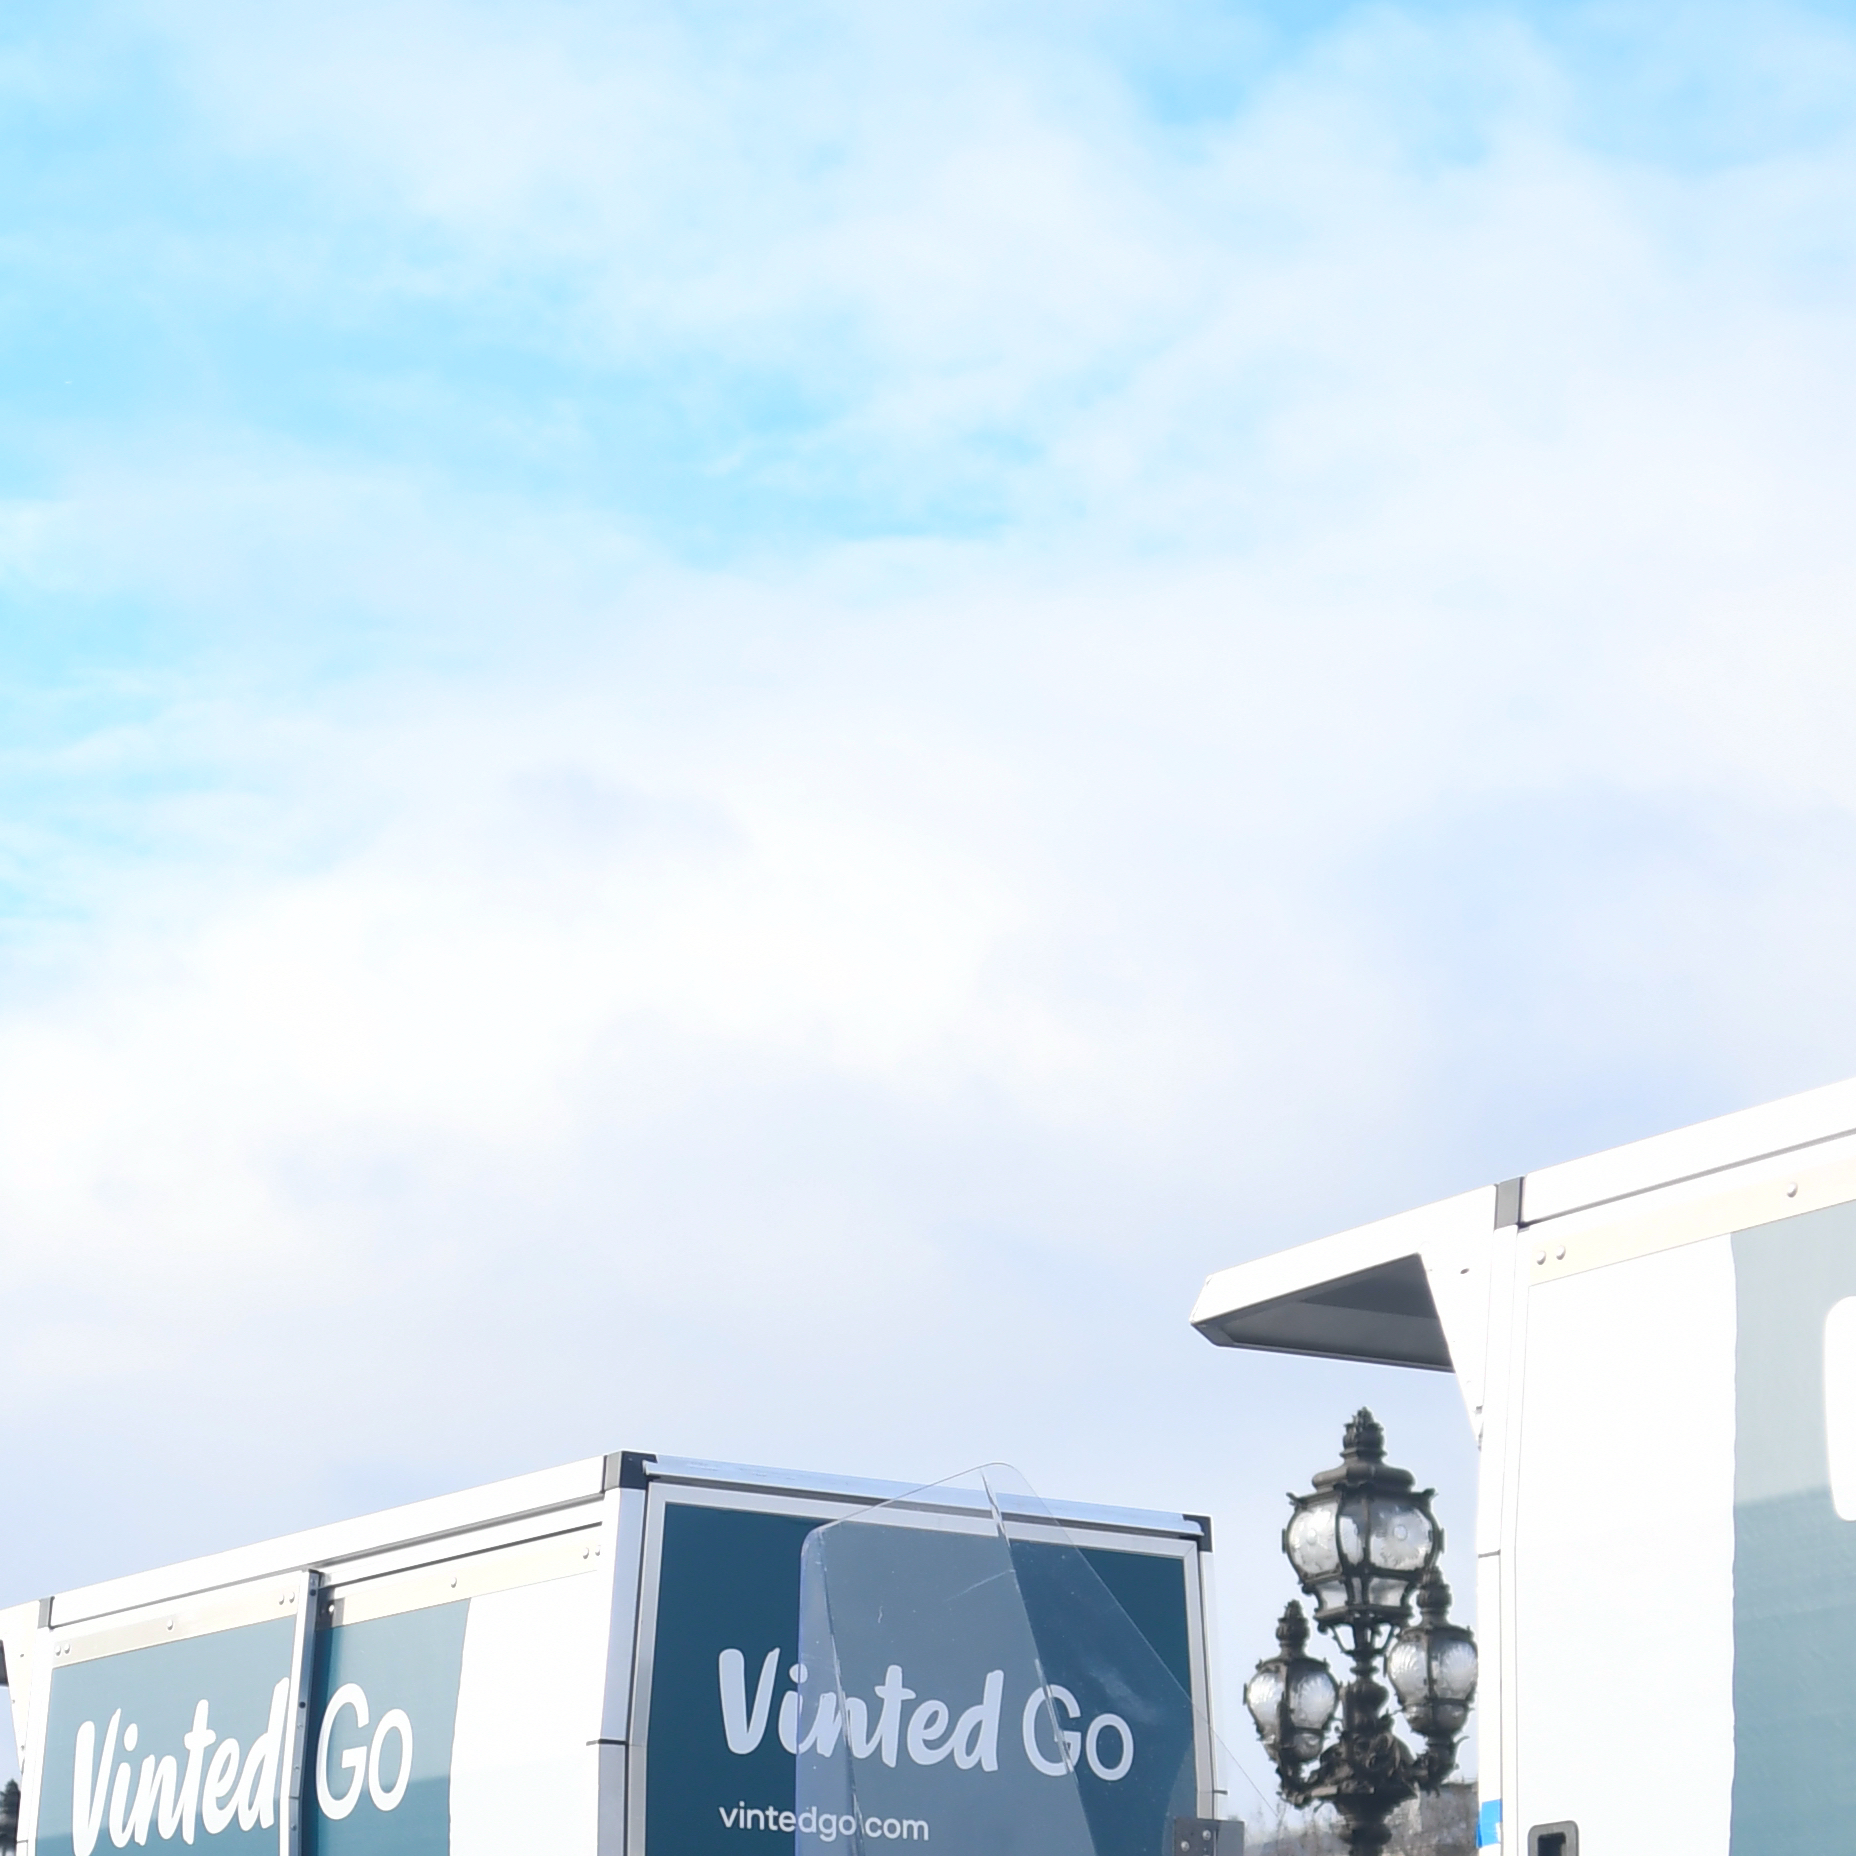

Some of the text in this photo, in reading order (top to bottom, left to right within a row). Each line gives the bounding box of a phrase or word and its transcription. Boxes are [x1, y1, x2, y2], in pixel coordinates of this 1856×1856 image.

[316, 1684, 413, 1819] Go
[718, 1647, 1134, 1781] Vinted Go
[718, 1801, 929, 1842] vintedgo.com
